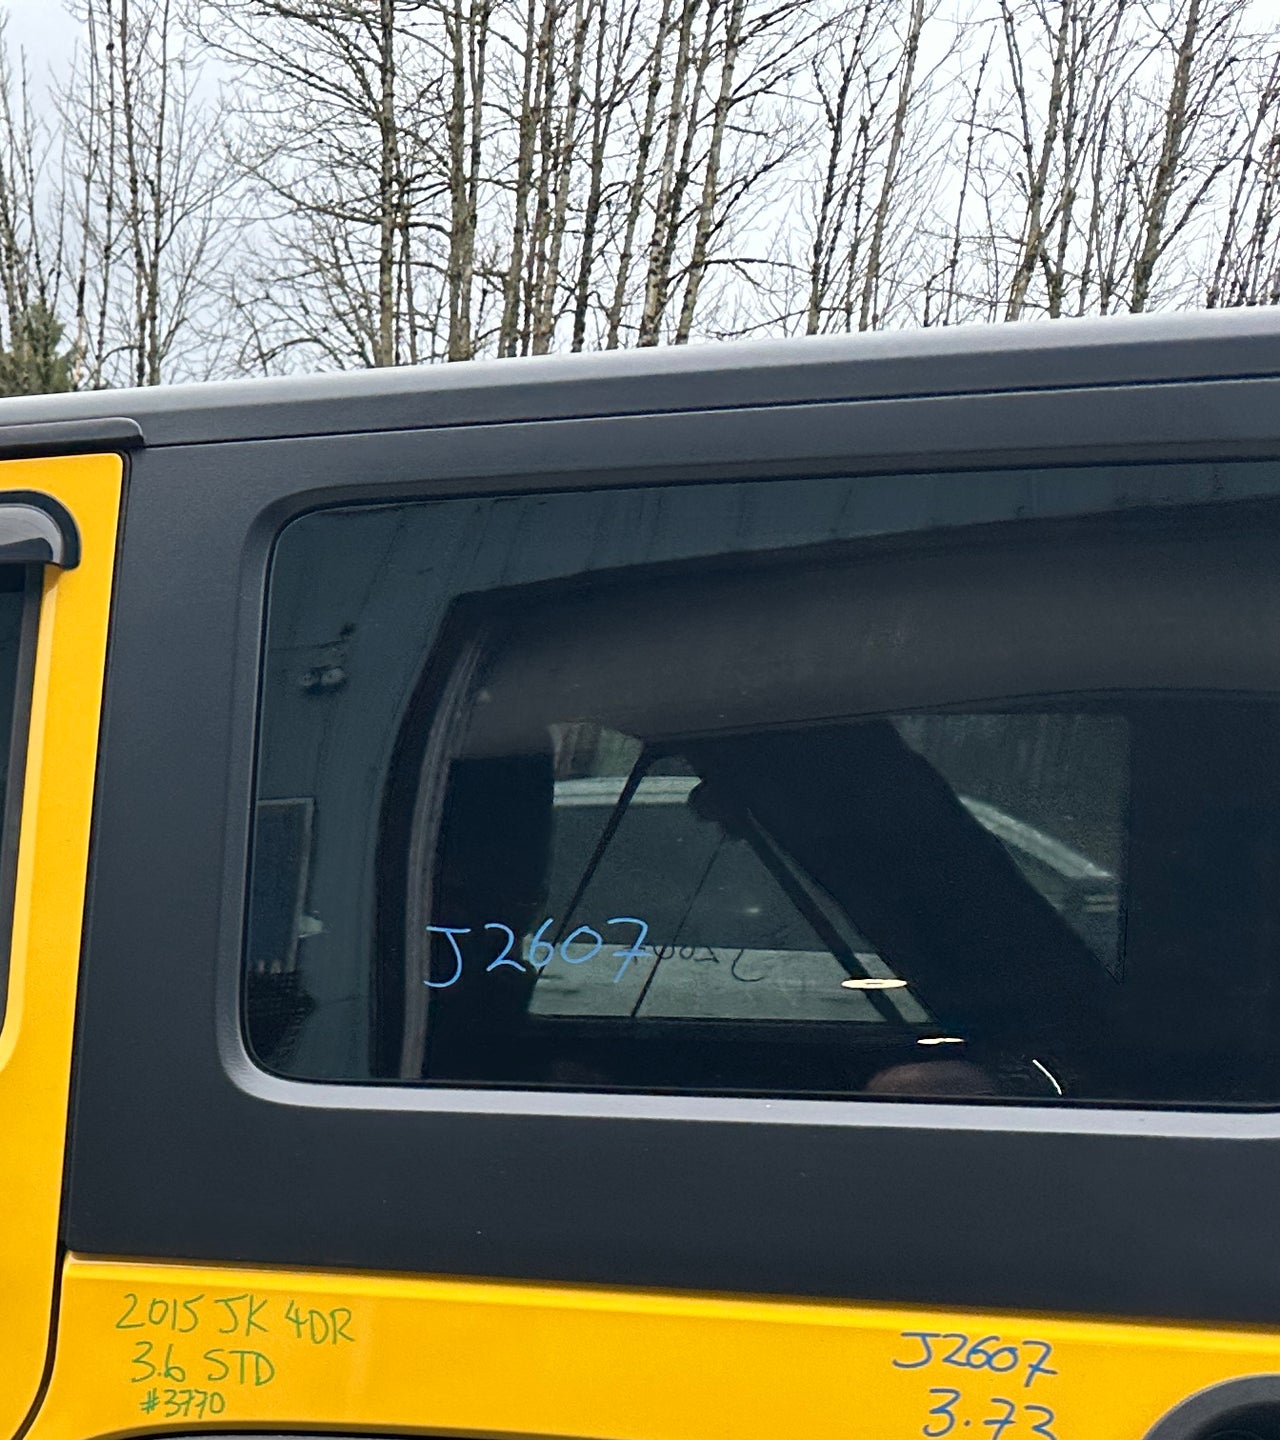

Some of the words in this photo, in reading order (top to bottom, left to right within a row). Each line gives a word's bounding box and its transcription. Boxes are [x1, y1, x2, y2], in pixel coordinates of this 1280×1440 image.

[423, 917, 653, 988] J2607
[115, 1293, 205, 1333] 2015
[214, 1293, 268, 1337] JK
[285, 1299, 356, 1345] 4DR
[131, 1340, 186, 1383] 3.6
[203, 1348, 276, 1387] STD
[892, 1331, 1059, 1388] J2607
[140, 1387, 226, 1419] #3770
